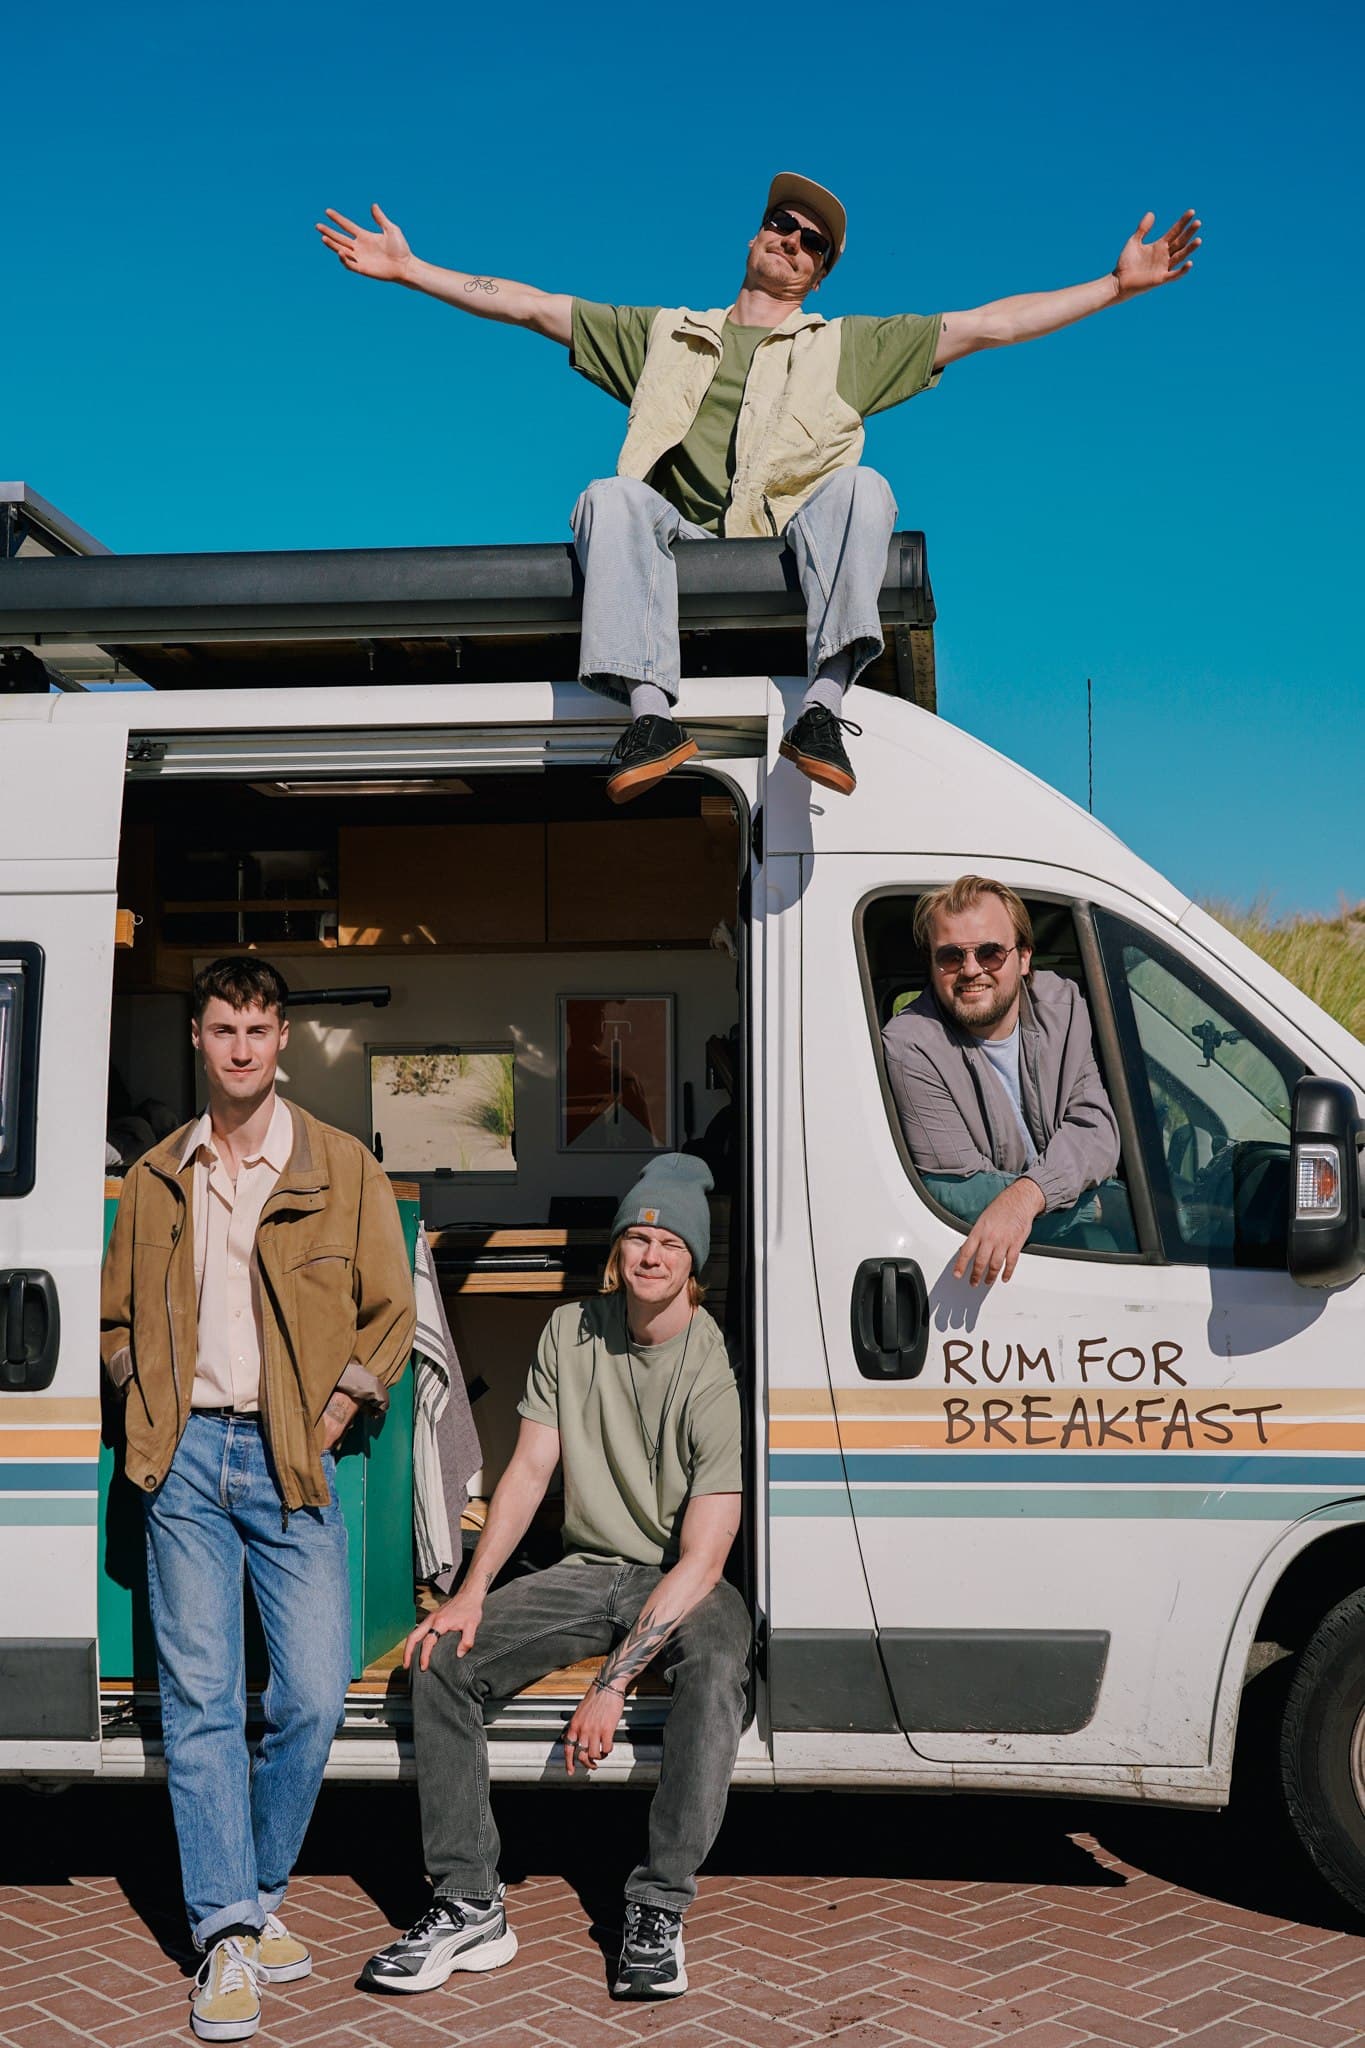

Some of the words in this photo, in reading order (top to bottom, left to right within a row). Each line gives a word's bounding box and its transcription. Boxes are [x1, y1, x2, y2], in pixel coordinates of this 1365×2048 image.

[942, 1339, 1056, 1385] RUM
[1077, 1336, 1187, 1387] FOR
[942, 1394, 1283, 1450] BREAKFAST
